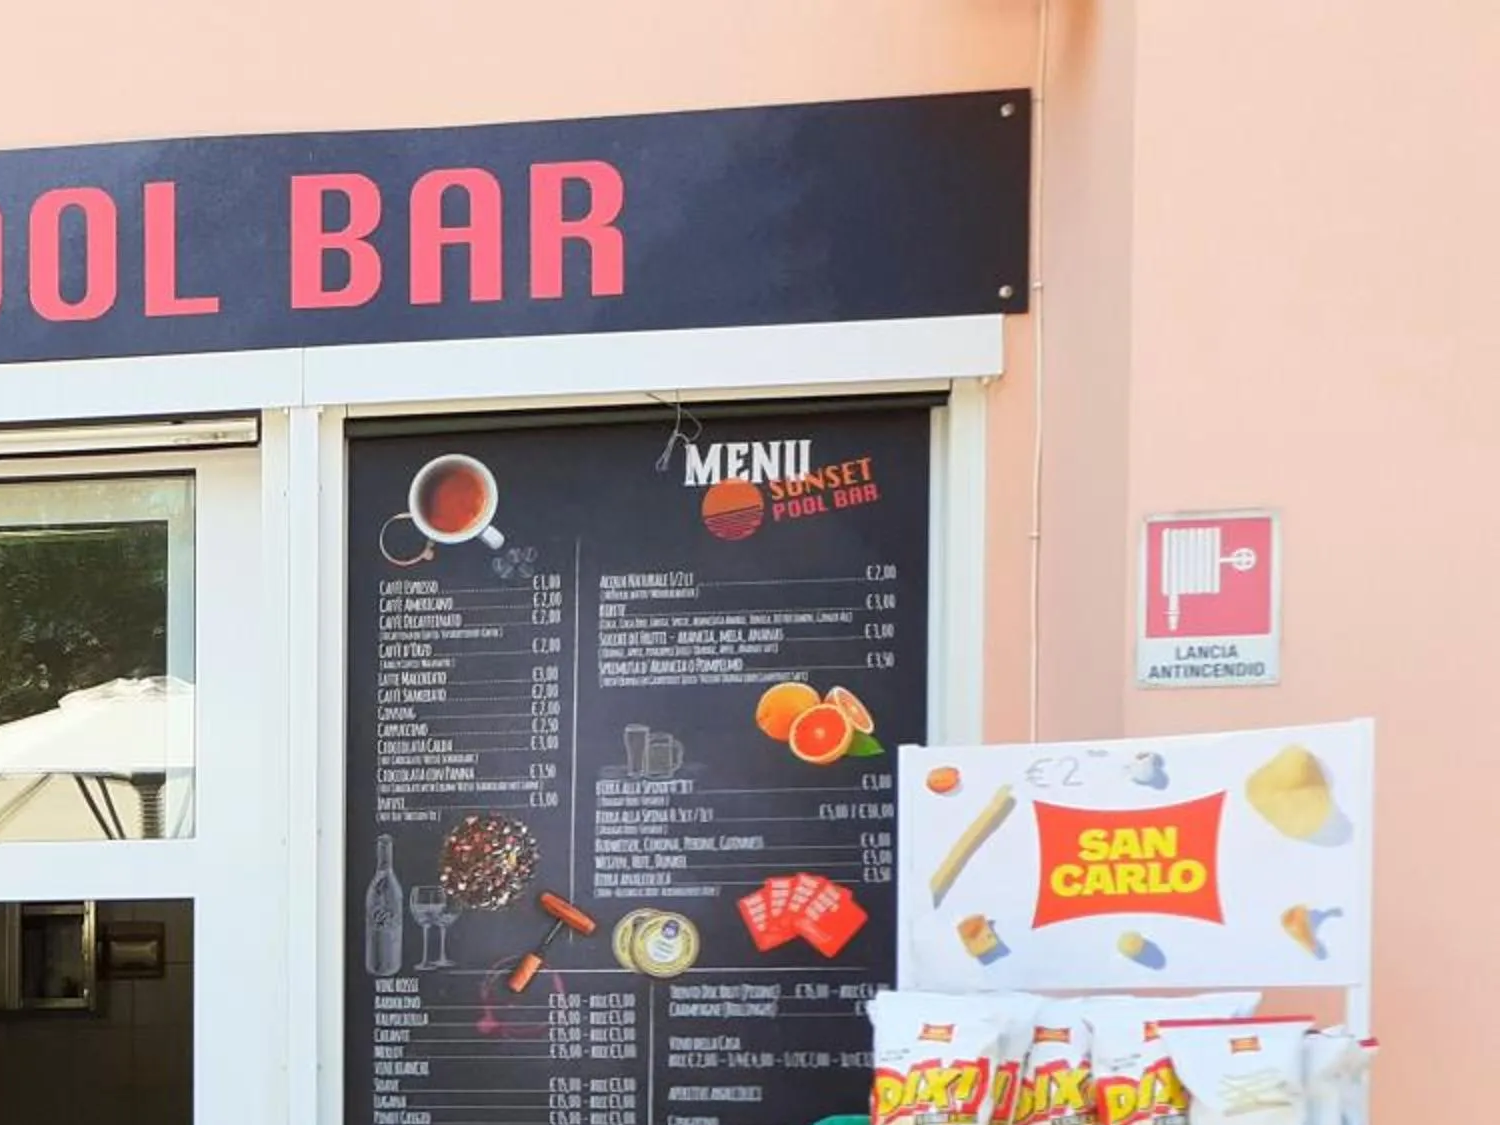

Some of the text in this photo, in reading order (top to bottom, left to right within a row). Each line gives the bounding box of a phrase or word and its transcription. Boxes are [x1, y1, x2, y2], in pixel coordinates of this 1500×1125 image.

[290, 159, 625, 310] BAR
[684, 439, 812, 487] MENU
[769, 456, 873, 501] SUNSET
[772, 483, 879, 522] POOL BAR
[1148, 661, 1266, 680] ANTINCENDIO
[1174, 644, 1239, 662] LANCIA
[1077, 826, 1179, 862] SAN
[1050, 859, 1208, 897] CARLO
